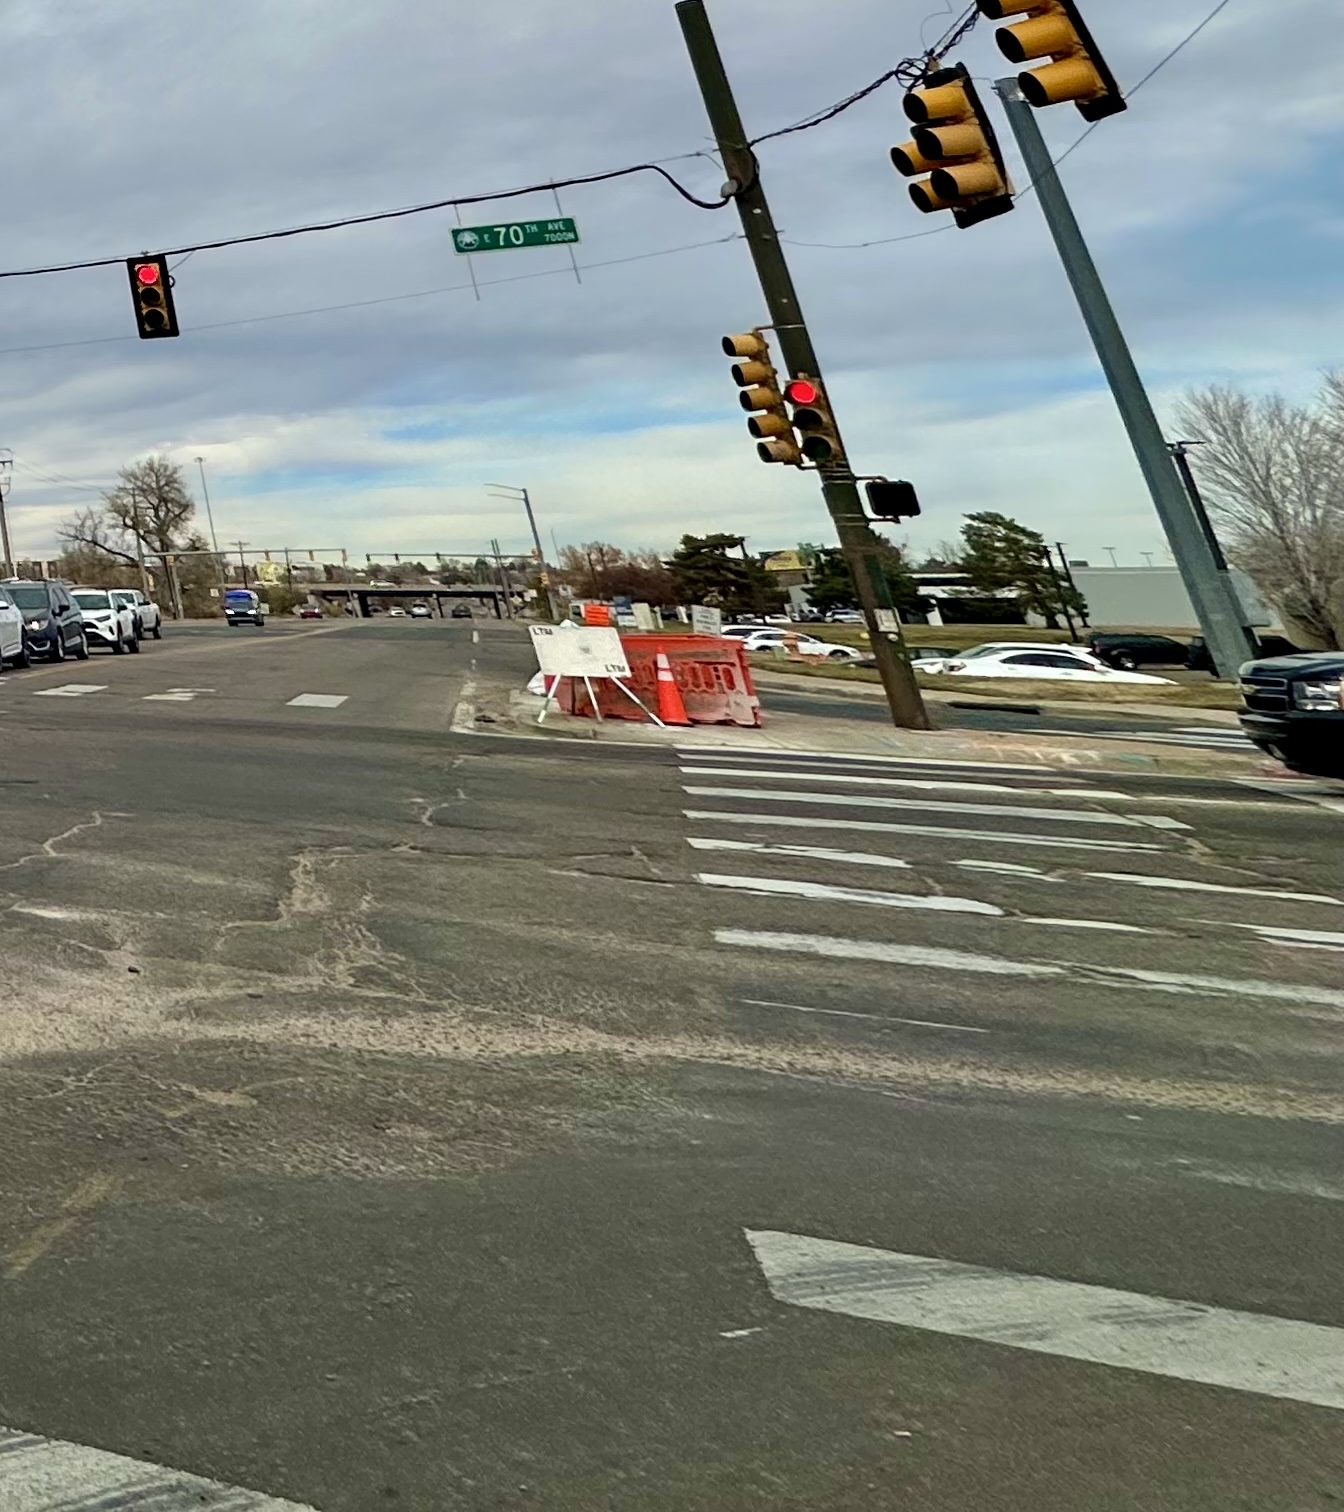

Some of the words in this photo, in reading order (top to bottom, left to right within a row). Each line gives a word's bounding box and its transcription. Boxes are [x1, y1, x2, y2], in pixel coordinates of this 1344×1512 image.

[484, 233, 491, 243] E
[547, 221, 565, 231] AVE
[543, 231, 575, 241] 7000N
